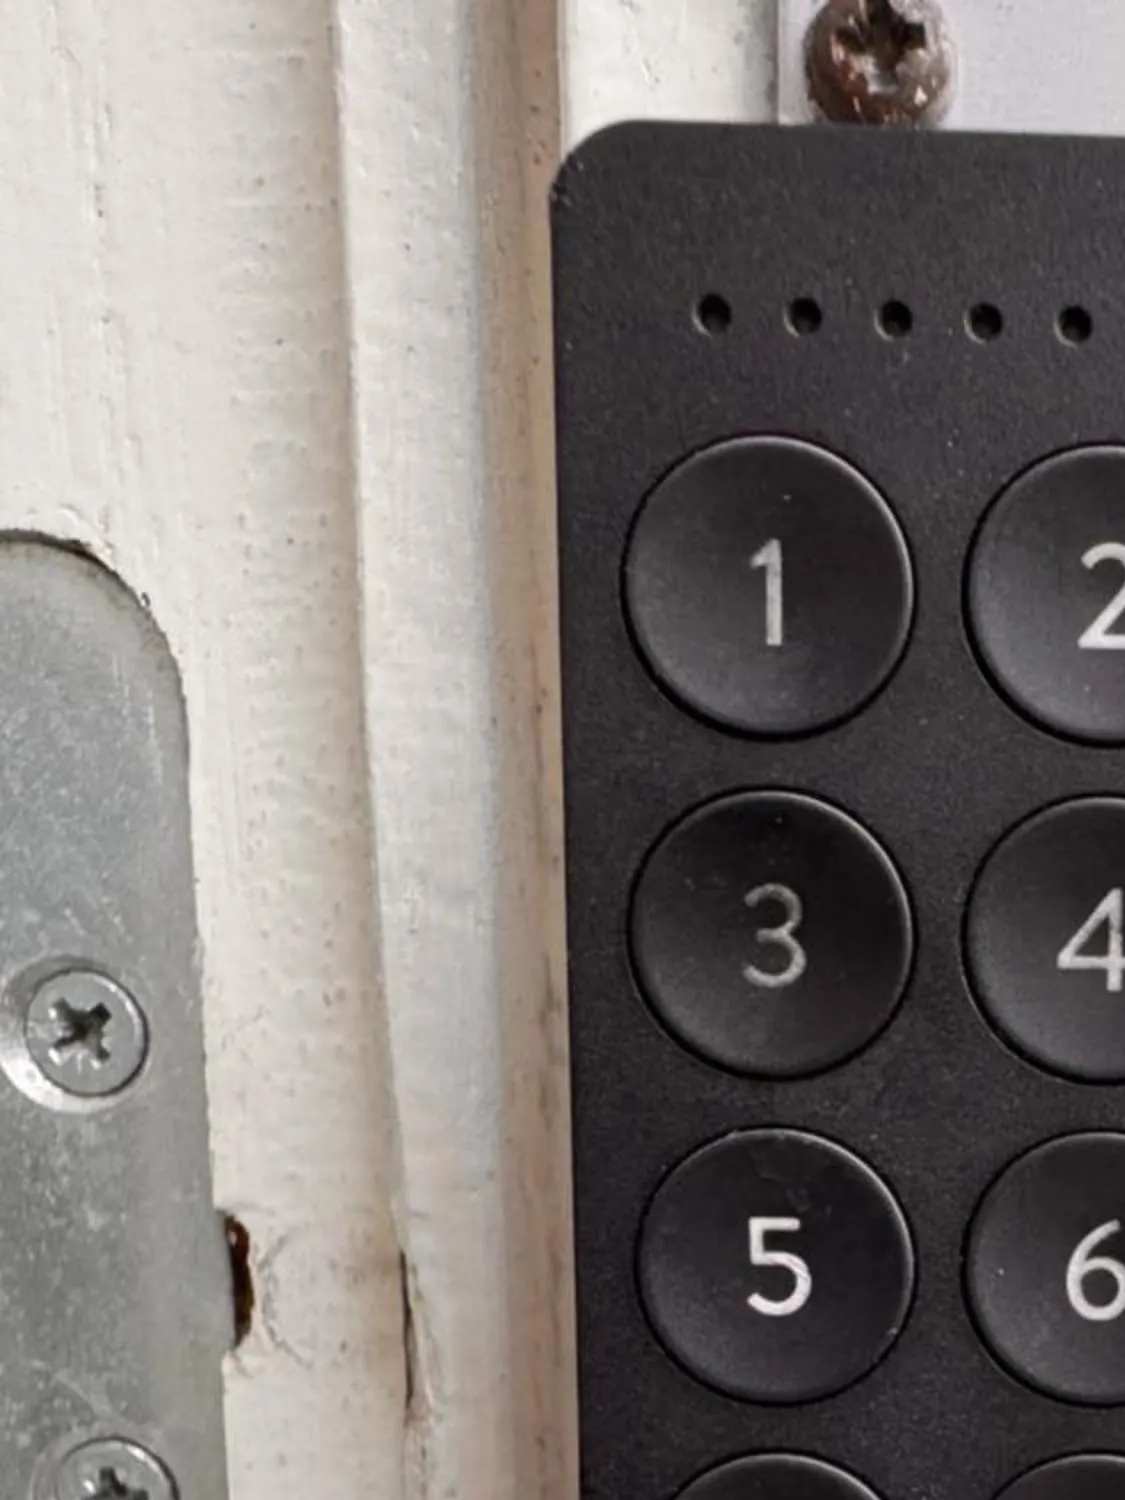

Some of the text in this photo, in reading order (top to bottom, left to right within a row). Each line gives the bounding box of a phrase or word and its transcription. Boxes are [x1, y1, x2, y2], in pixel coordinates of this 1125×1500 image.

[750, 538, 784, 646] 1
[743, 882, 807, 989] 3
[747, 1216, 812, 1317] 5
